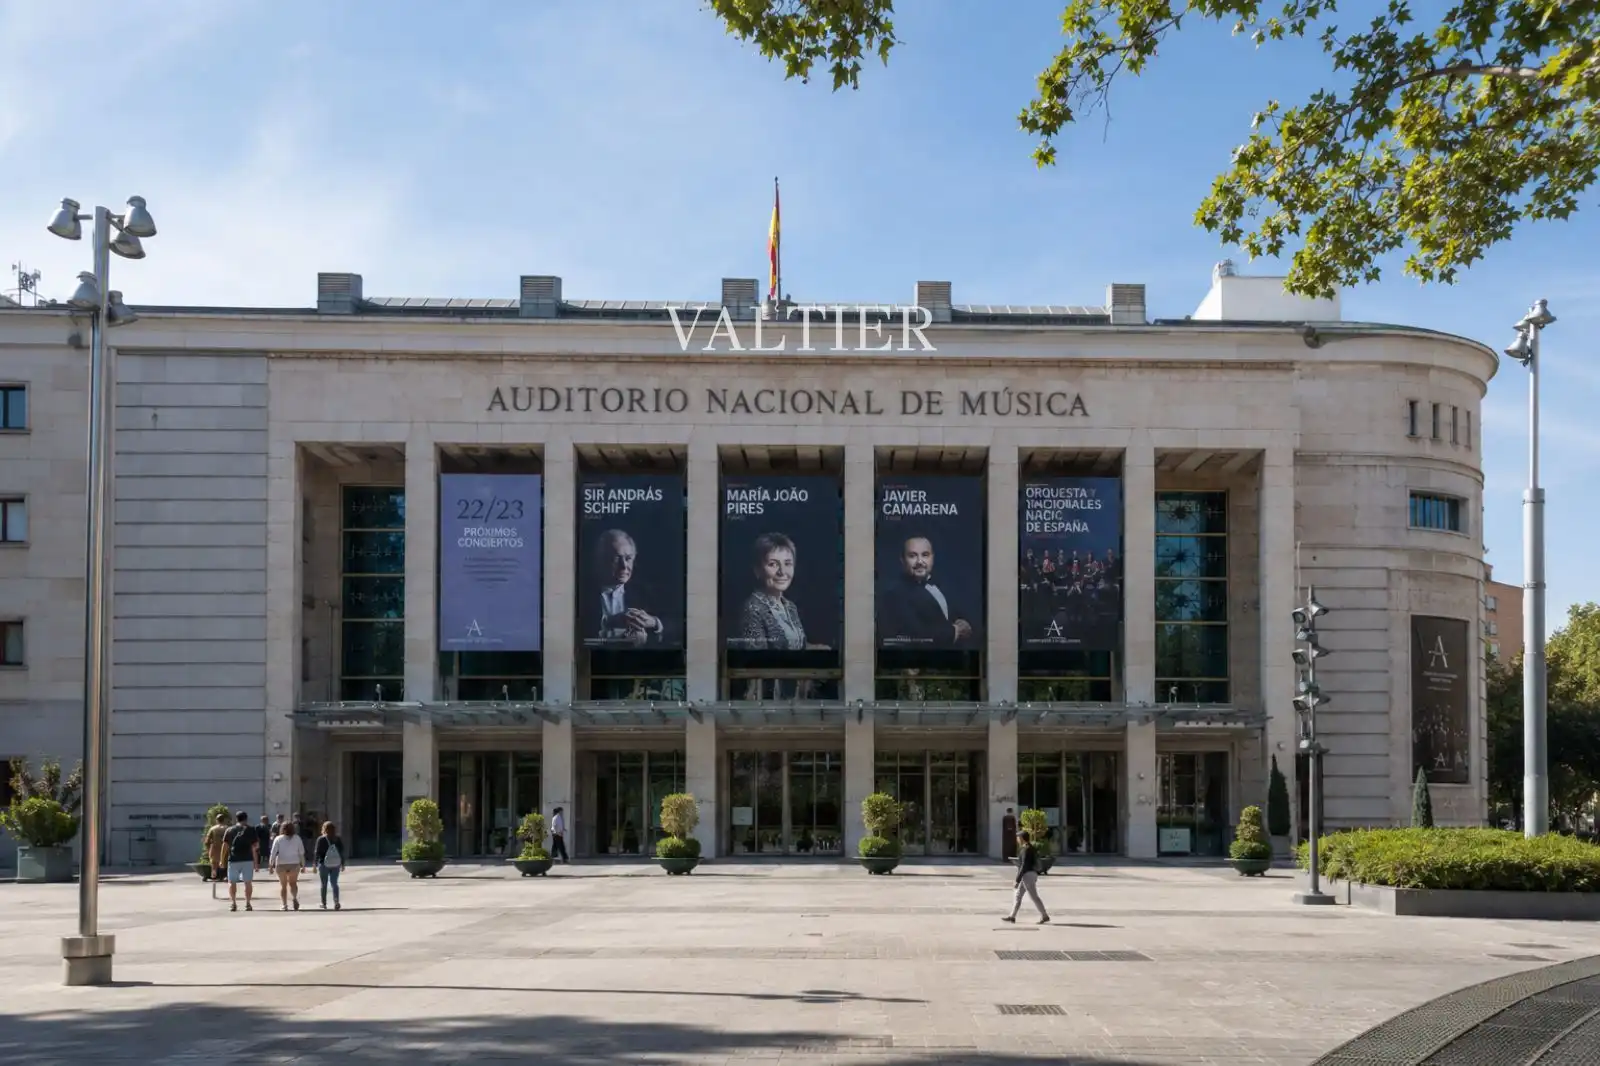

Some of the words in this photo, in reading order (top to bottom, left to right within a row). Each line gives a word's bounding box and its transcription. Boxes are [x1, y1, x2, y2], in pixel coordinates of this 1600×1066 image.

[487, 386, 688, 413] AUDITORIO
[706, 389, 884, 415] NACIONAL
[901, 391, 943, 416] DE
[960, 387, 1090, 417] MÚSICA
[584, 489, 604, 501] SIR
[608, 485, 663, 501] ANDRÁS
[727, 487, 771, 502] MARÍA
[773, 487, 809, 502] JOÃO
[883, 490, 927, 502] JAVIER
[1026, 488, 1088, 498] ORQUESTA
[457, 496, 524, 523] 22/23
[584, 502, 630, 514] SCHIFF
[727, 503, 764, 514] PIRES
[883, 504, 958, 515] CAMARENA
[464, 526, 517, 537] PRÓXIMOS
[1026, 522, 1041, 533] DE
[1044, 520, 1090, 533] ESPAÑA
[458, 538, 523, 548] CONCIERTOS
